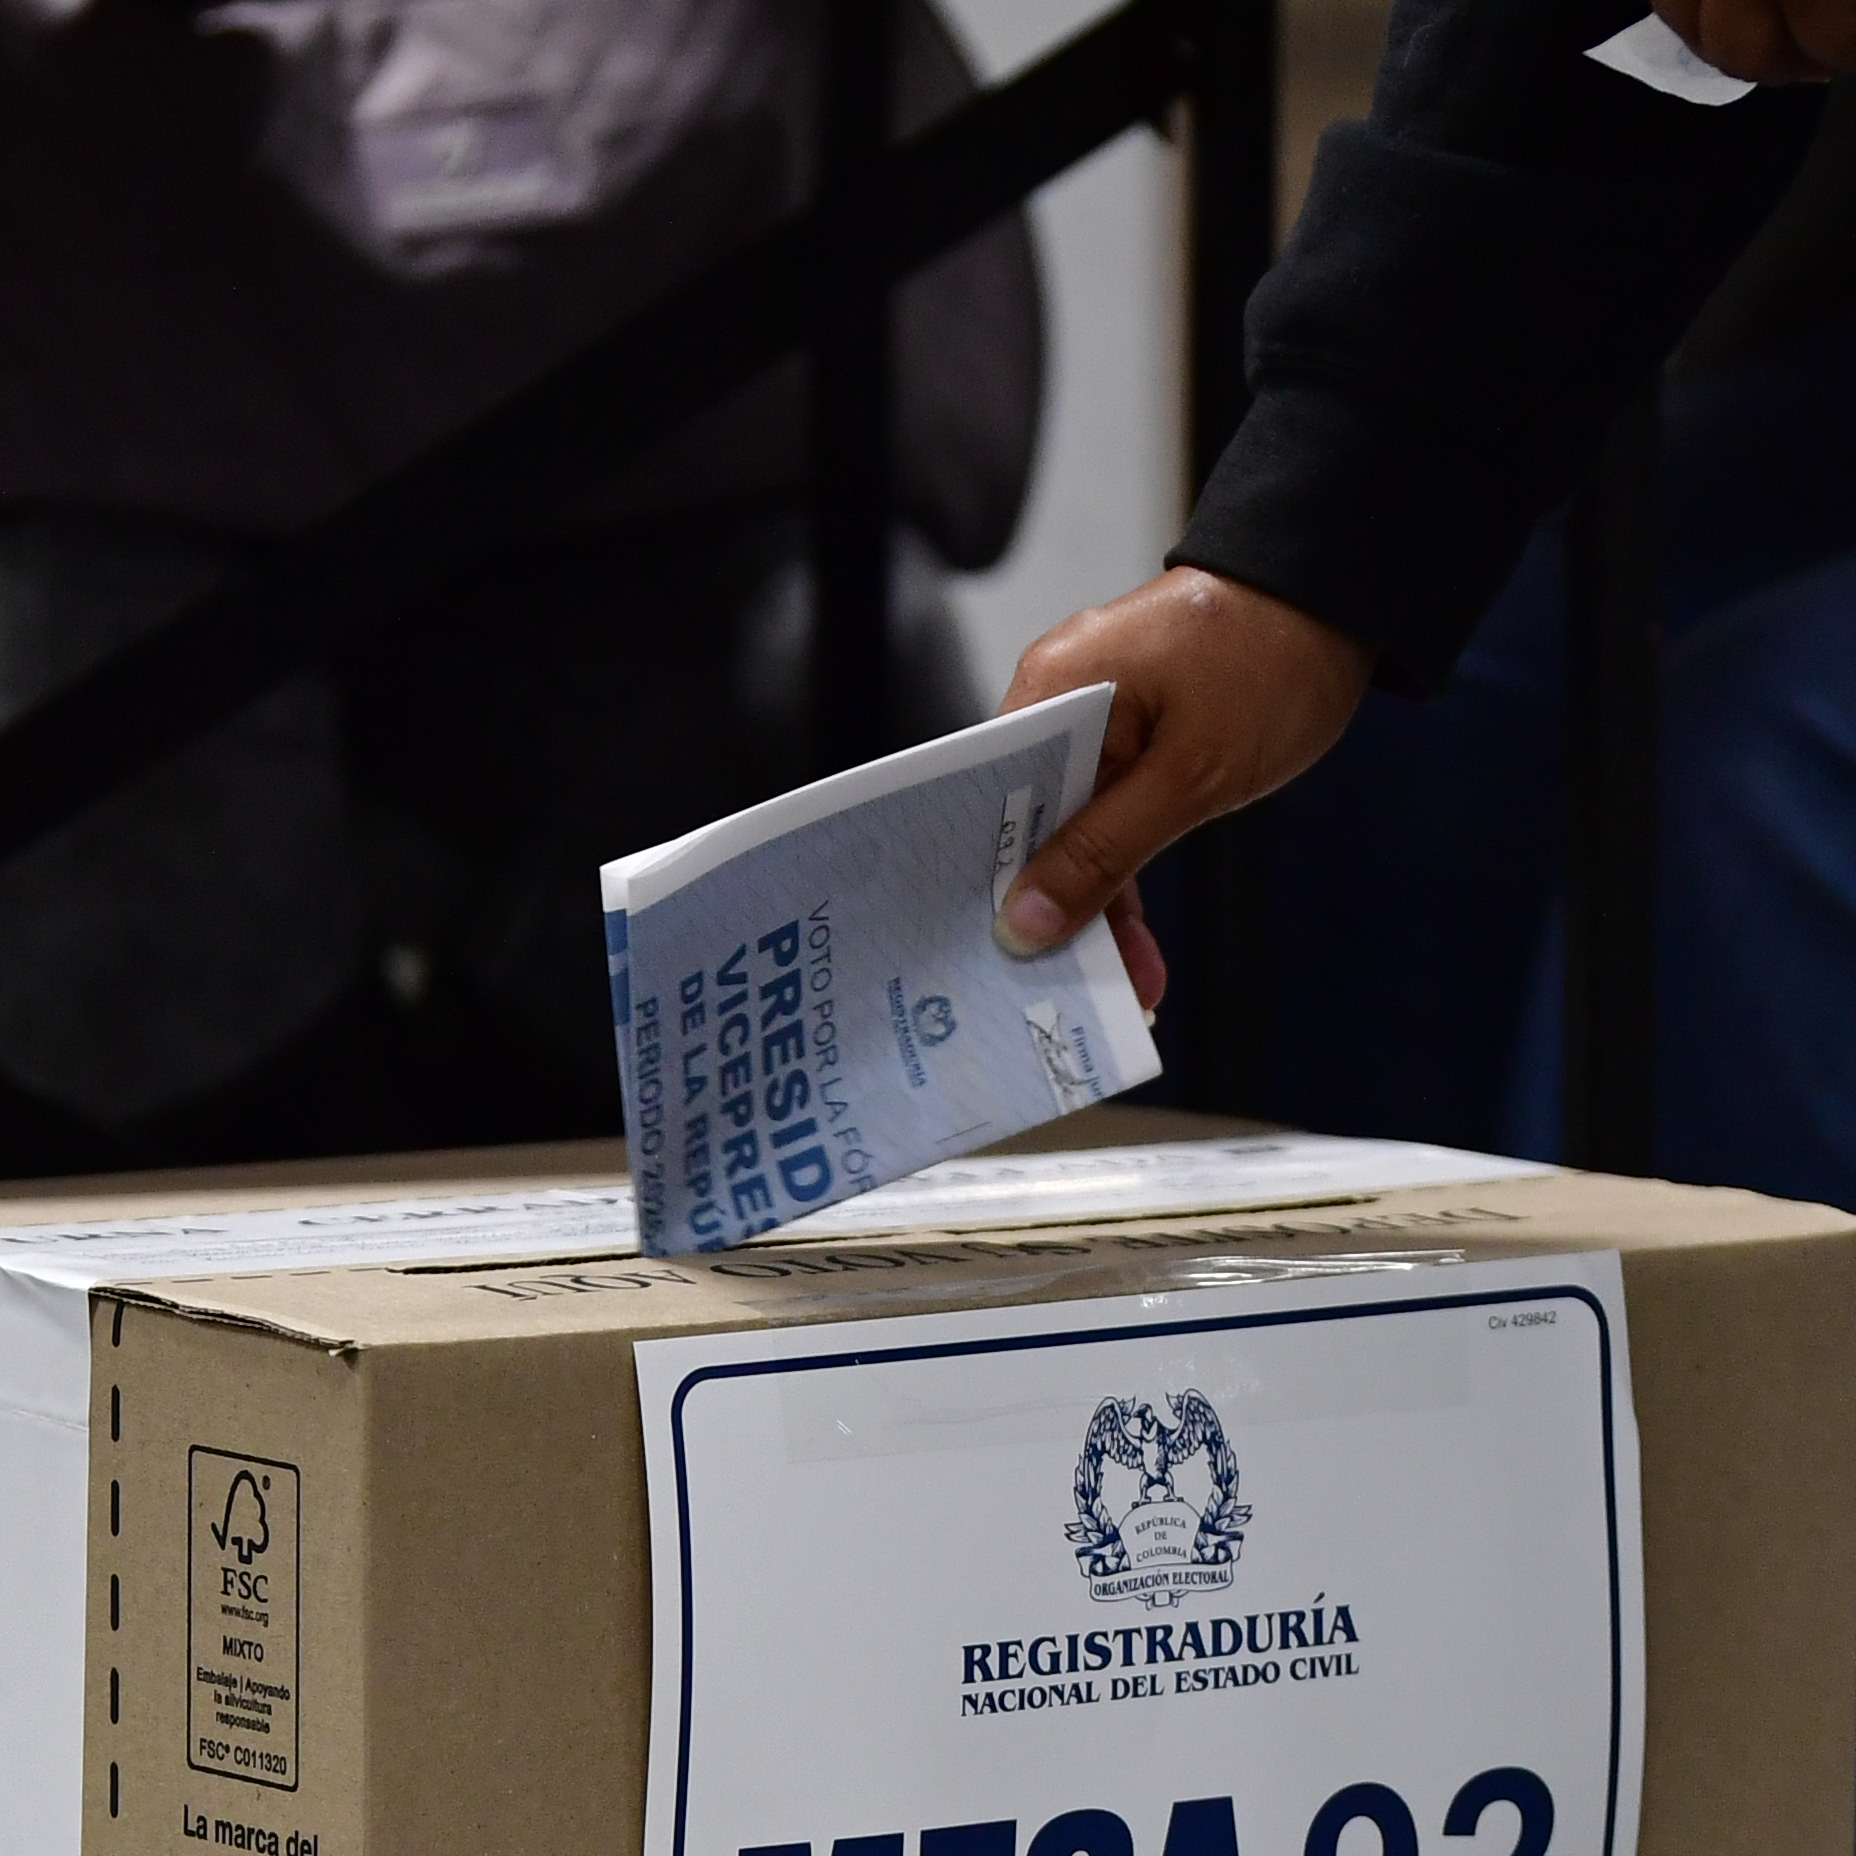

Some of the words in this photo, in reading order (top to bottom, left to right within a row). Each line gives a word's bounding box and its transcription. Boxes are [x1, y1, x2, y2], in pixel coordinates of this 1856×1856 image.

[808, 900, 833, 993] VOTO
[680, 970, 706, 1036] DE
[812, 999, 840, 1072] POR
[636, 996, 665, 1157] PERIODO
[682, 1042, 708, 1105] LA
[758, 919, 834, 1202] PRESID
[820, 1076, 848, 1124] LA
[710, 1246, 968, 1278] VOTO
[464, 1269, 696, 1301] AQUÍ
[1134, 1516, 1186, 1535] REPÚBLICA
[1154, 1531, 1167, 1541] DE
[1136, 1547, 1187, 1563] COLOMBIA
[221, 1567, 268, 1603] FSC
[1094, 1569, 1169, 1596] ORGANIZACIÓN
[1172, 1570, 1229, 1585] ELECTORAL
[222, 1635, 264, 1663] MIXTO
[961, 1592, 1359, 1684] REGISTRADURÍA
[197, 1667, 238, 1693] Embalaje
[245, 1678, 291, 1701] Apoyando
[961, 1681, 1101, 1717] NACIONAL
[1110, 1675, 1164, 1701] DEL
[1175, 1660, 1280, 1694] ESTADO
[1289, 1653, 1360, 1680] CIVIL
[216, 1711, 270, 1734] responsable
[234, 1745, 287, 1775] C011320
[184, 1804, 208, 1840] La
[214, 1819, 279, 1856] marca
